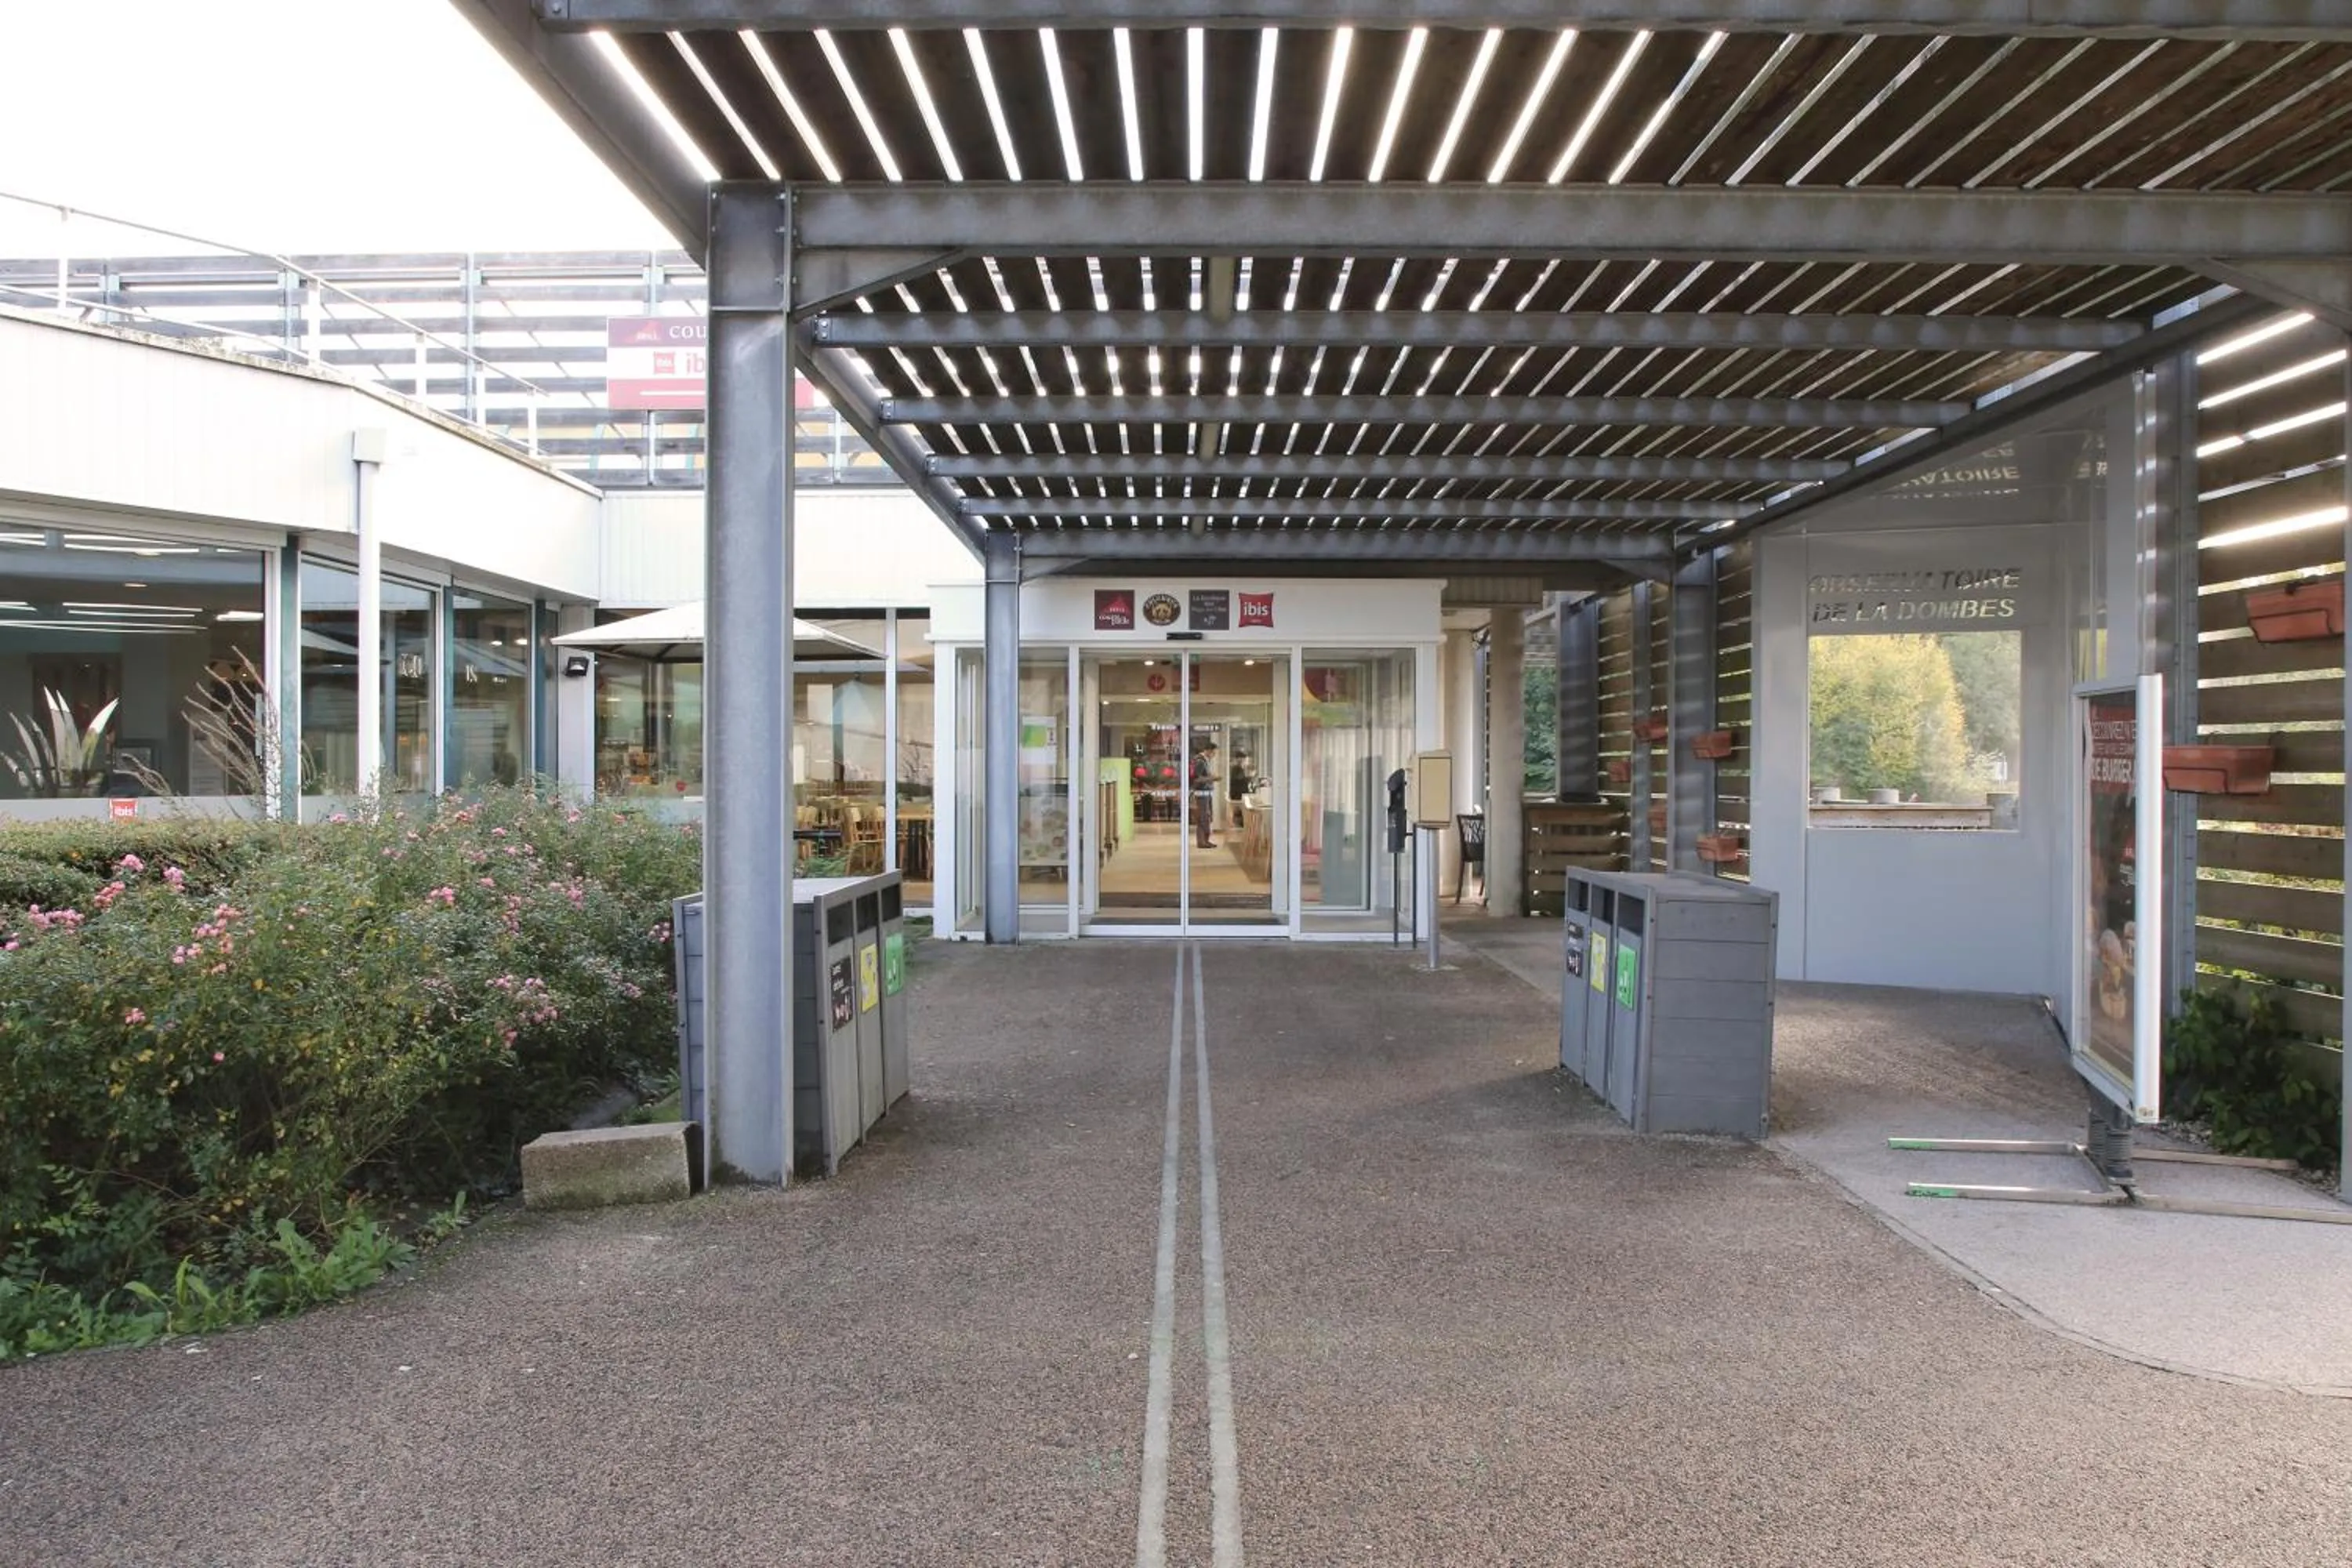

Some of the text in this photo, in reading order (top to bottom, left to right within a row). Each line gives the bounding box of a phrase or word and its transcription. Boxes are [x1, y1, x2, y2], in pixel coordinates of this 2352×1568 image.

[1807, 568, 2022, 593] OBSERVATOIRE
[1243, 601, 1269, 615] ibis
[1812, 598, 2016, 622] DE LA DOMBES
